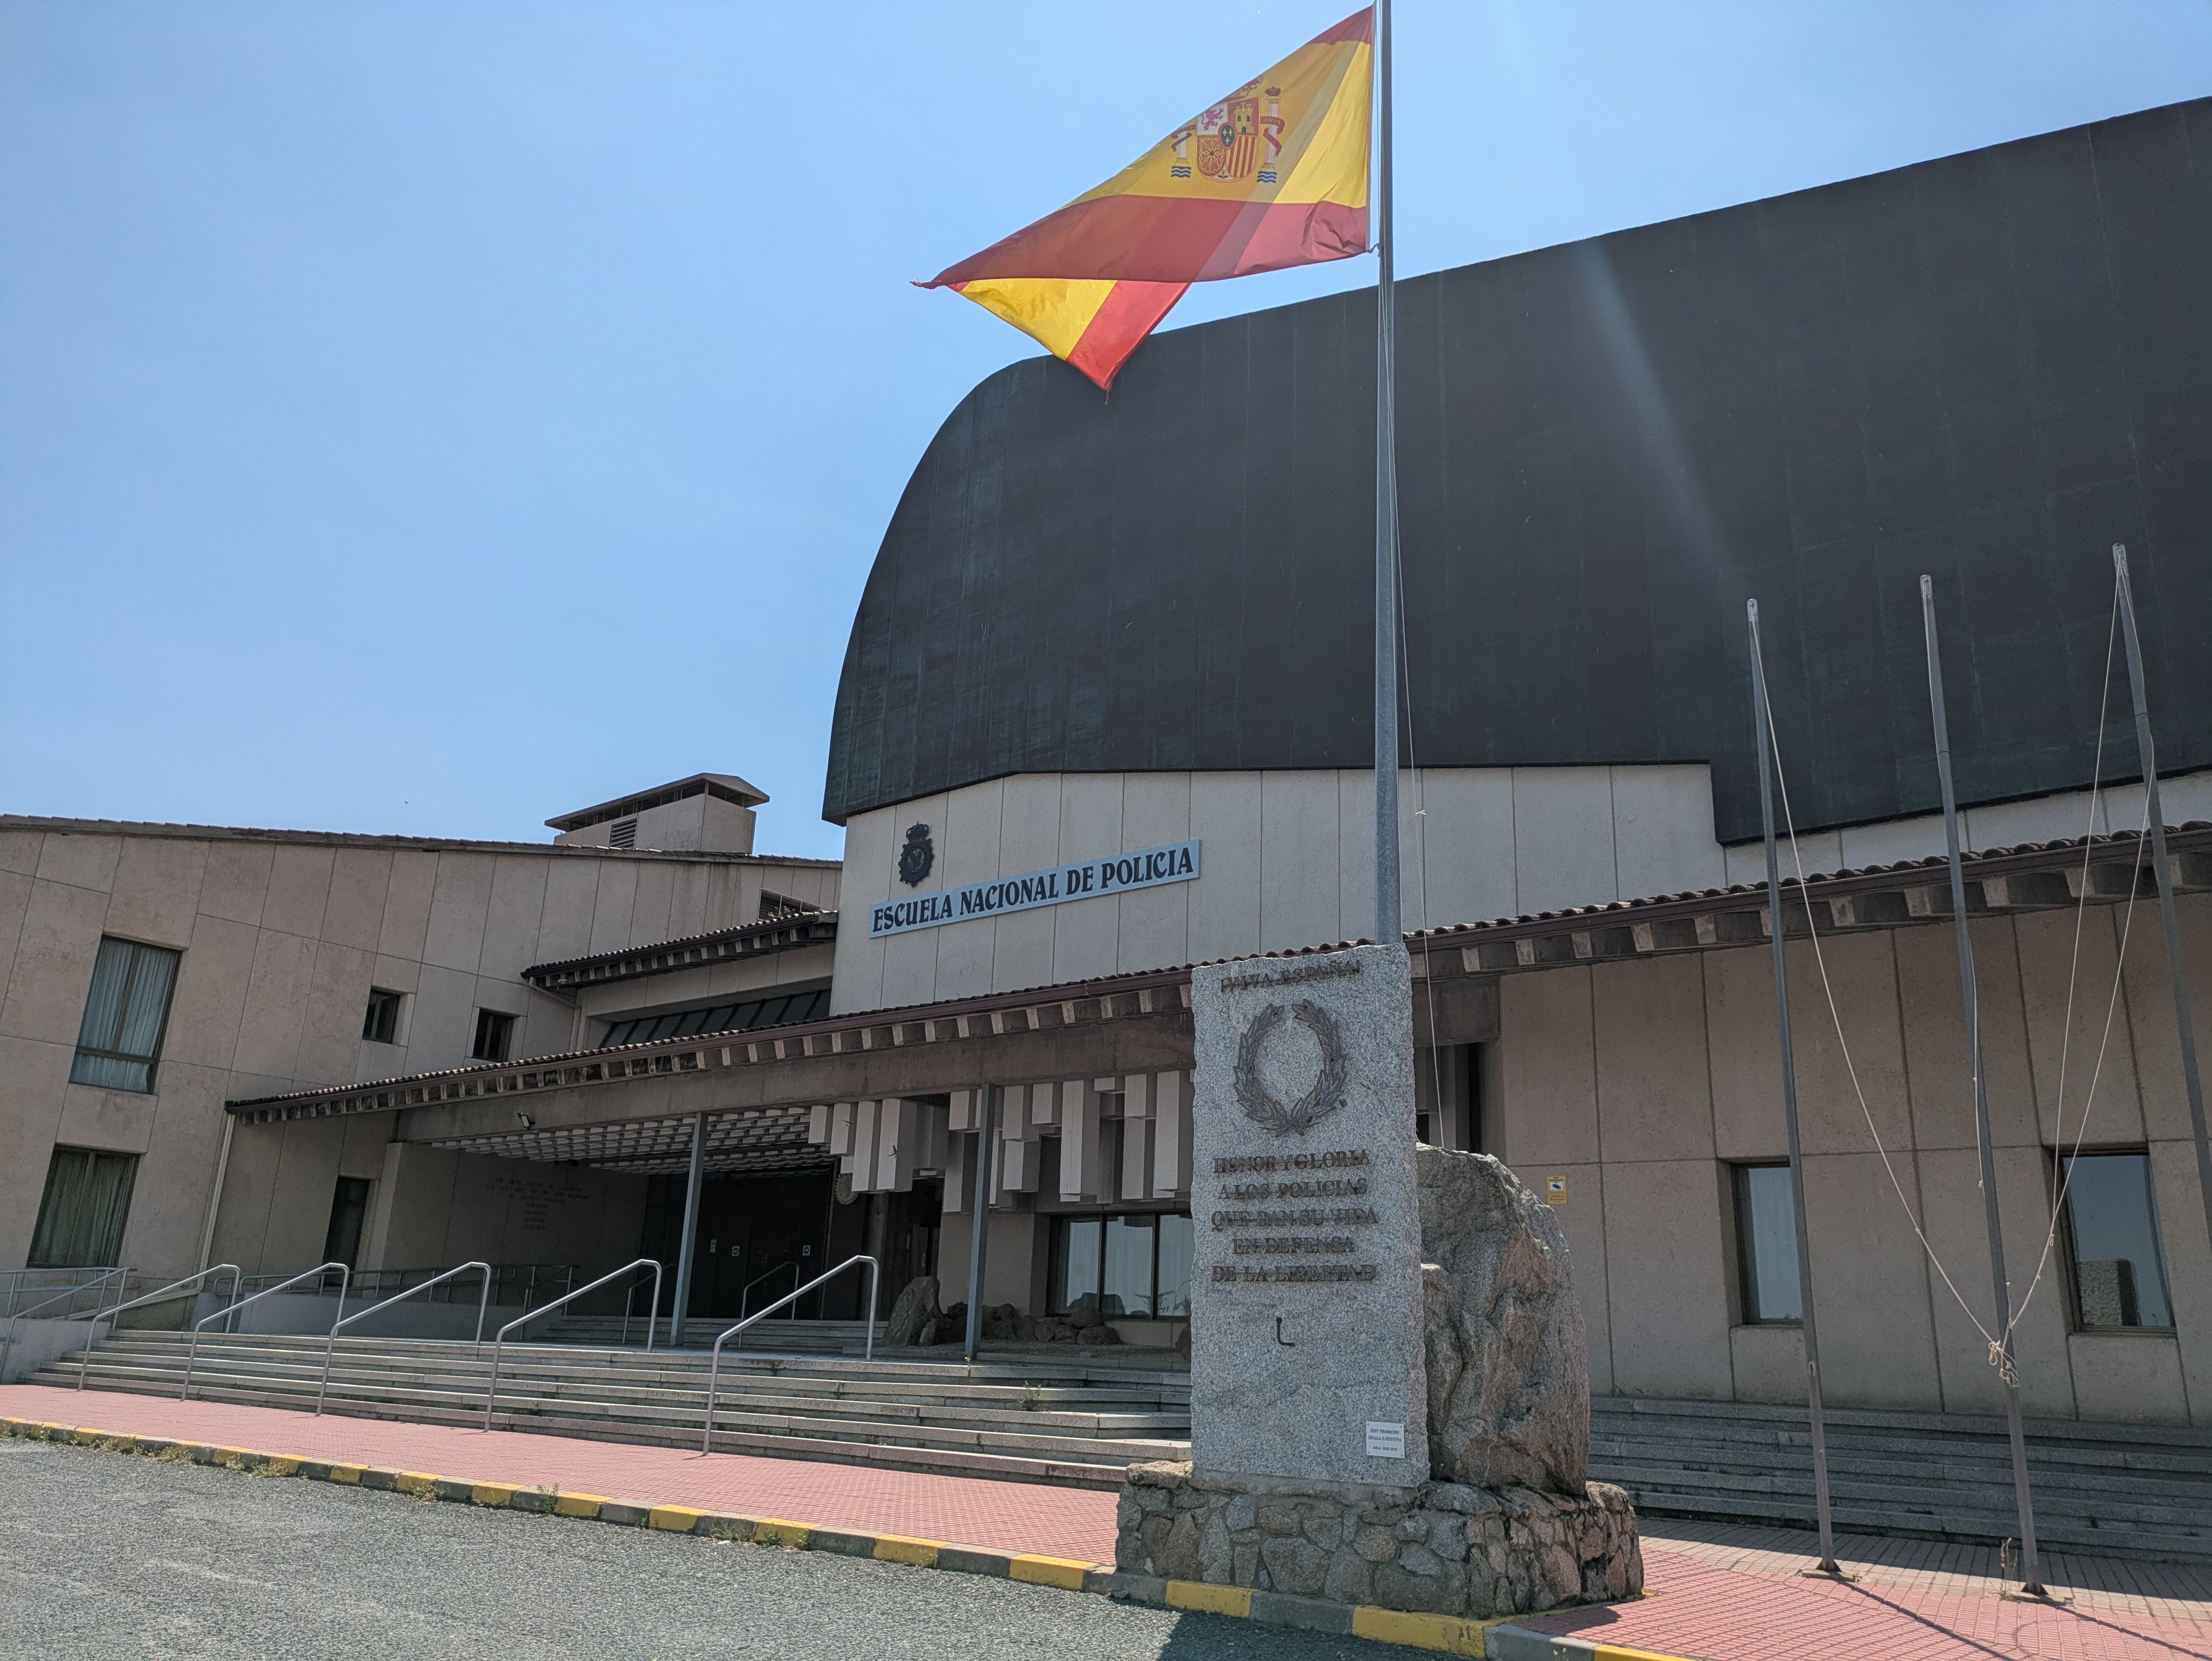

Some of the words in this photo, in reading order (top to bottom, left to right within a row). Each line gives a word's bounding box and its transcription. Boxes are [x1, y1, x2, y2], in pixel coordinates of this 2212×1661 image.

[873, 894, 953, 932] ESCUELA
[960, 874, 1060, 916] NACIONAL
[1066, 866, 1094, 896] DE
[1101, 847, 1194, 889] POLICIA
[1213, 1155, 1278, 1173] HONOR
[1282, 1154, 1292, 1171] Y
[1294, 1149, 1371, 1170] GLORIA
[1218, 1184, 1231, 1199] A
[1233, 1183, 1269, 1200] LOS
[1211, 1210, 1250, 1231] QUE
[1255, 1210, 1294, 1227] DAN
[1299, 1209, 1325, 1227] SU
[1330, 1207, 1379, 1225] VIDA
[1232, 1238, 1259, 1254] EN
[1263, 1236, 1356, 1254] DEFENSA
[1211, 1265, 1237, 1282] DE
[1244, 1266, 1268, 1283] LA
[1274, 1263, 1377, 1283] LIBERTAD
